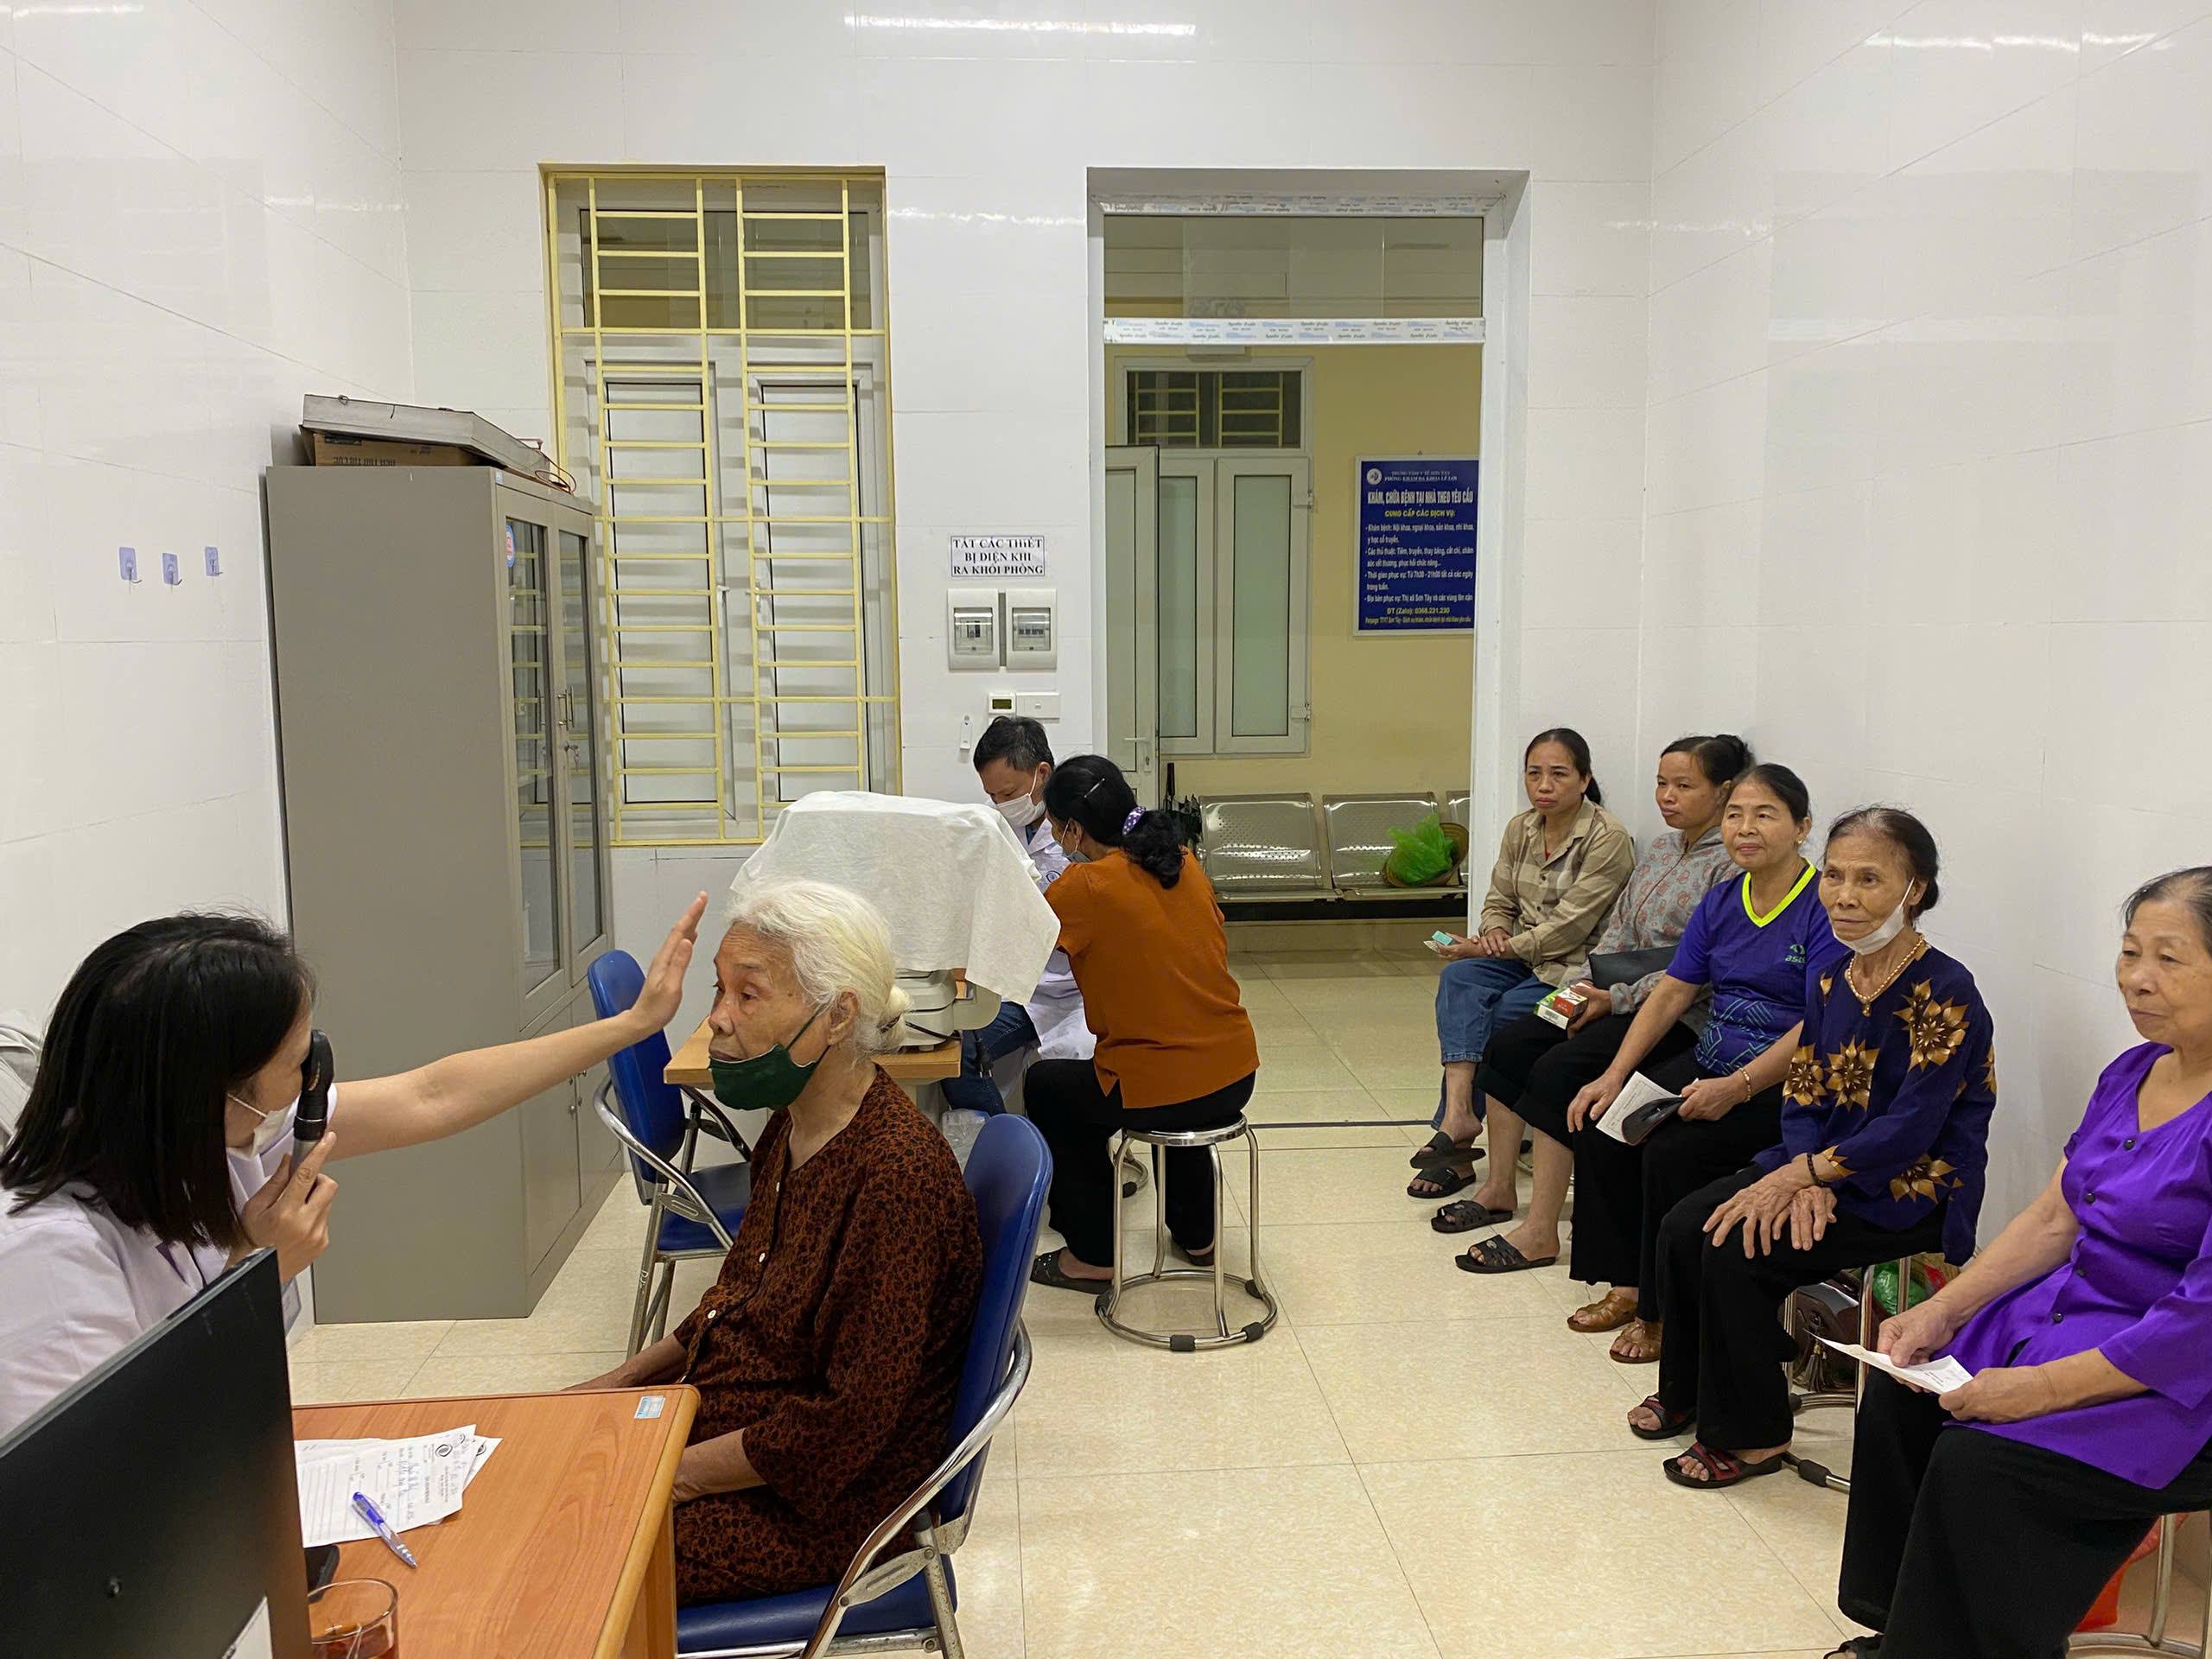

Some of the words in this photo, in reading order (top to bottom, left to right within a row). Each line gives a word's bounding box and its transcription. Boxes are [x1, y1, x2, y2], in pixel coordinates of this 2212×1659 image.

[1437, 490, 1451, 504] THEO
[979, 537, 1004, 548] CÁC
[964, 552, 976, 564] BỊ
[1011, 552, 1032, 562] KHI
[953, 565, 969, 575] RA
[1003, 563, 1043, 575] PHÒNG
